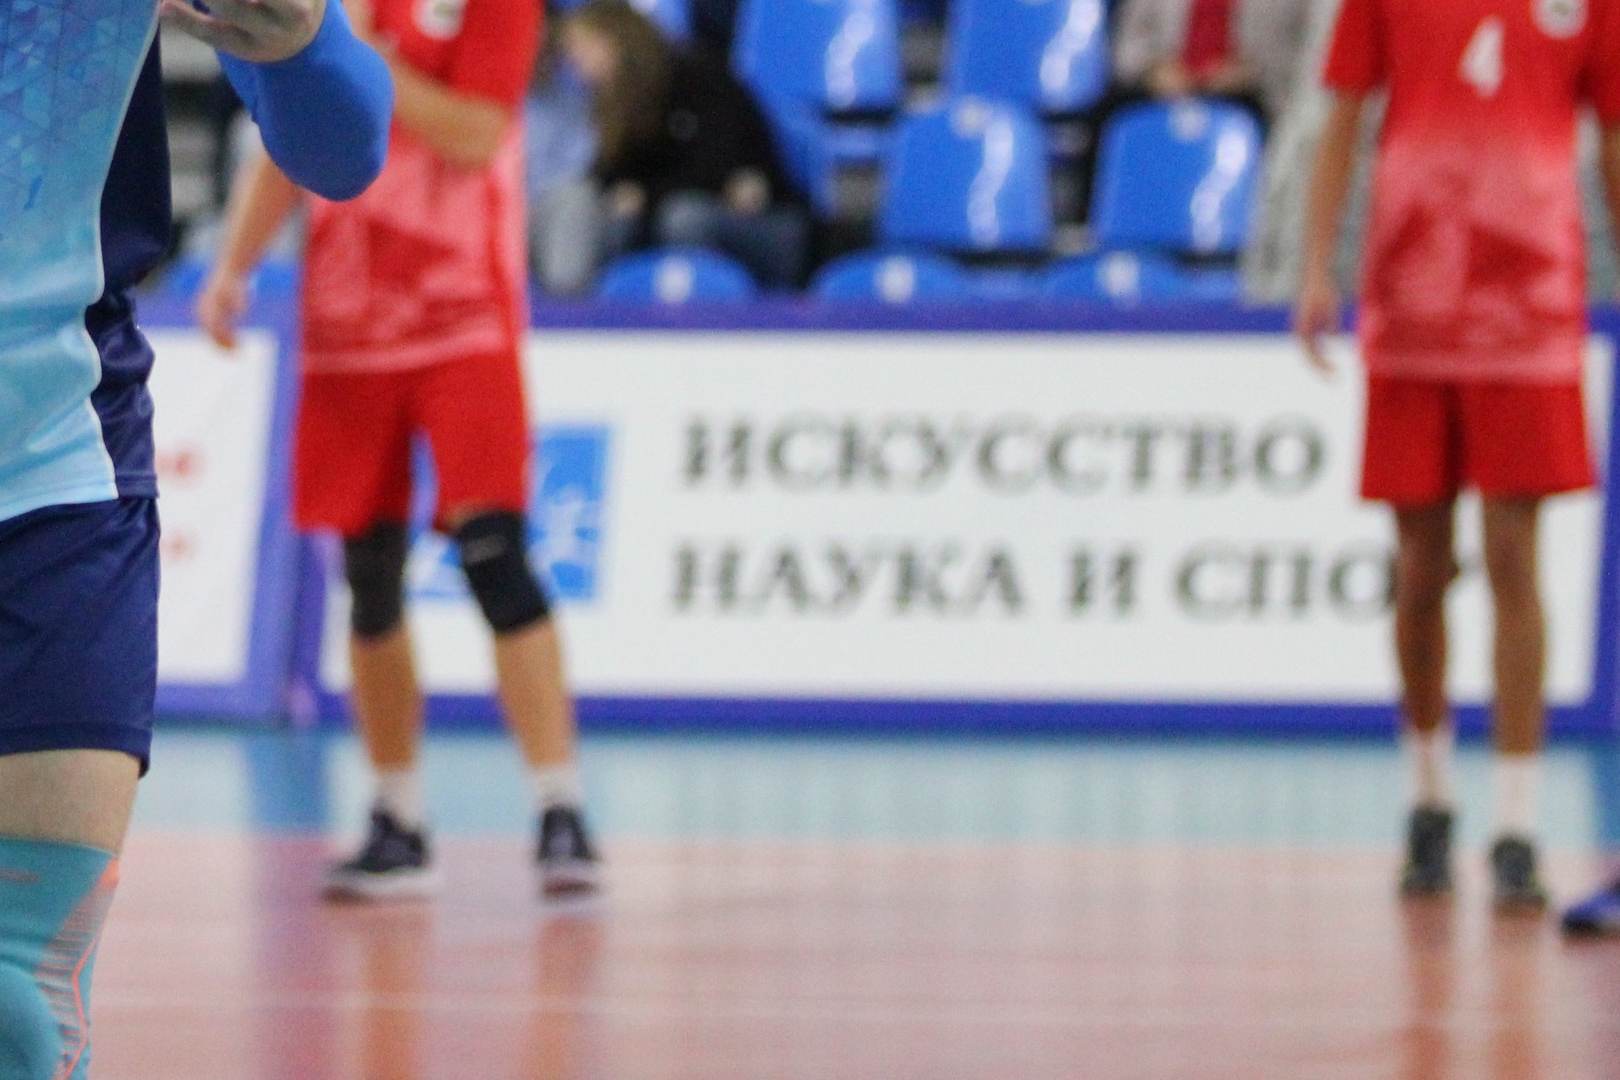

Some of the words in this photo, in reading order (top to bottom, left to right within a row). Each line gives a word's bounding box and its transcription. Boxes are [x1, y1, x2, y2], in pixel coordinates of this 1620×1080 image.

[1458, 15, 1505, 98] 4
[682, 413, 1324, 495] ИСКУССТВО
[671, 535, 1023, 617] НАУКА
[1067, 537, 1138, 617] И
[1173, 533, 1402, 620] СПО
